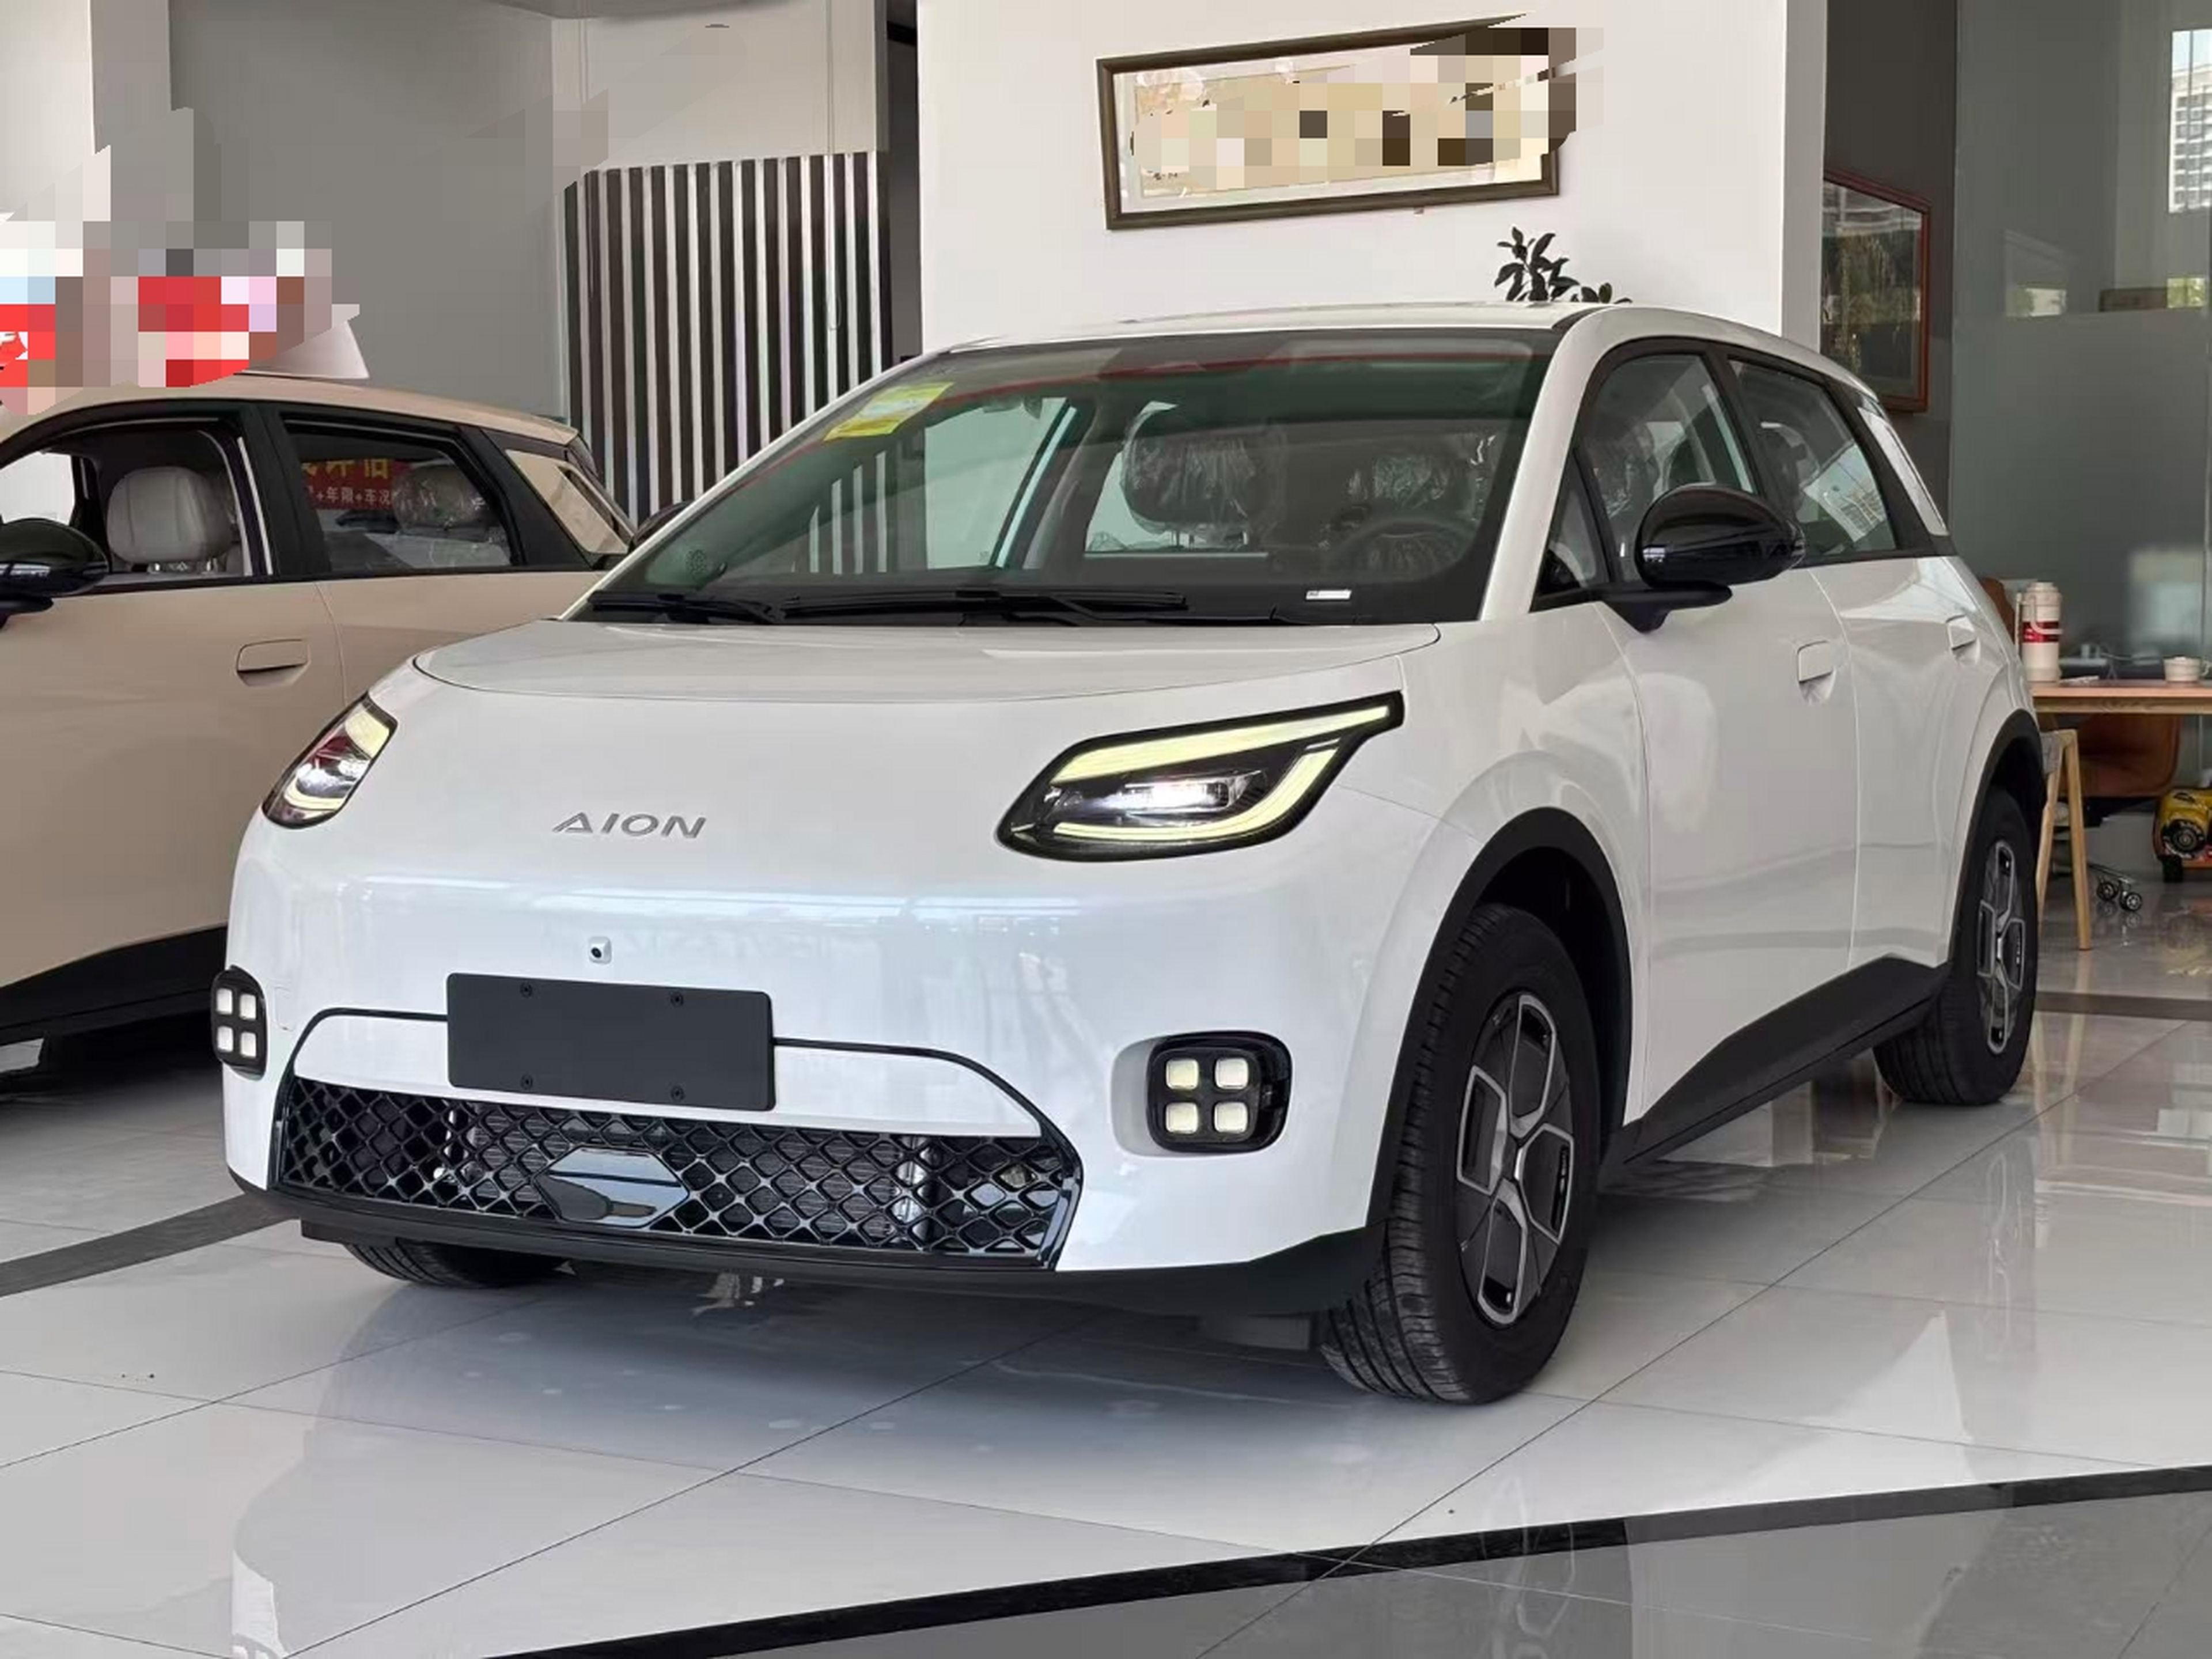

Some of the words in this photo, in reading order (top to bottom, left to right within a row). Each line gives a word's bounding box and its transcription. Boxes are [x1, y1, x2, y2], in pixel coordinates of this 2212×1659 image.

[308, 486, 391, 505] +年限+车况
[552, 812, 706, 838] AION
